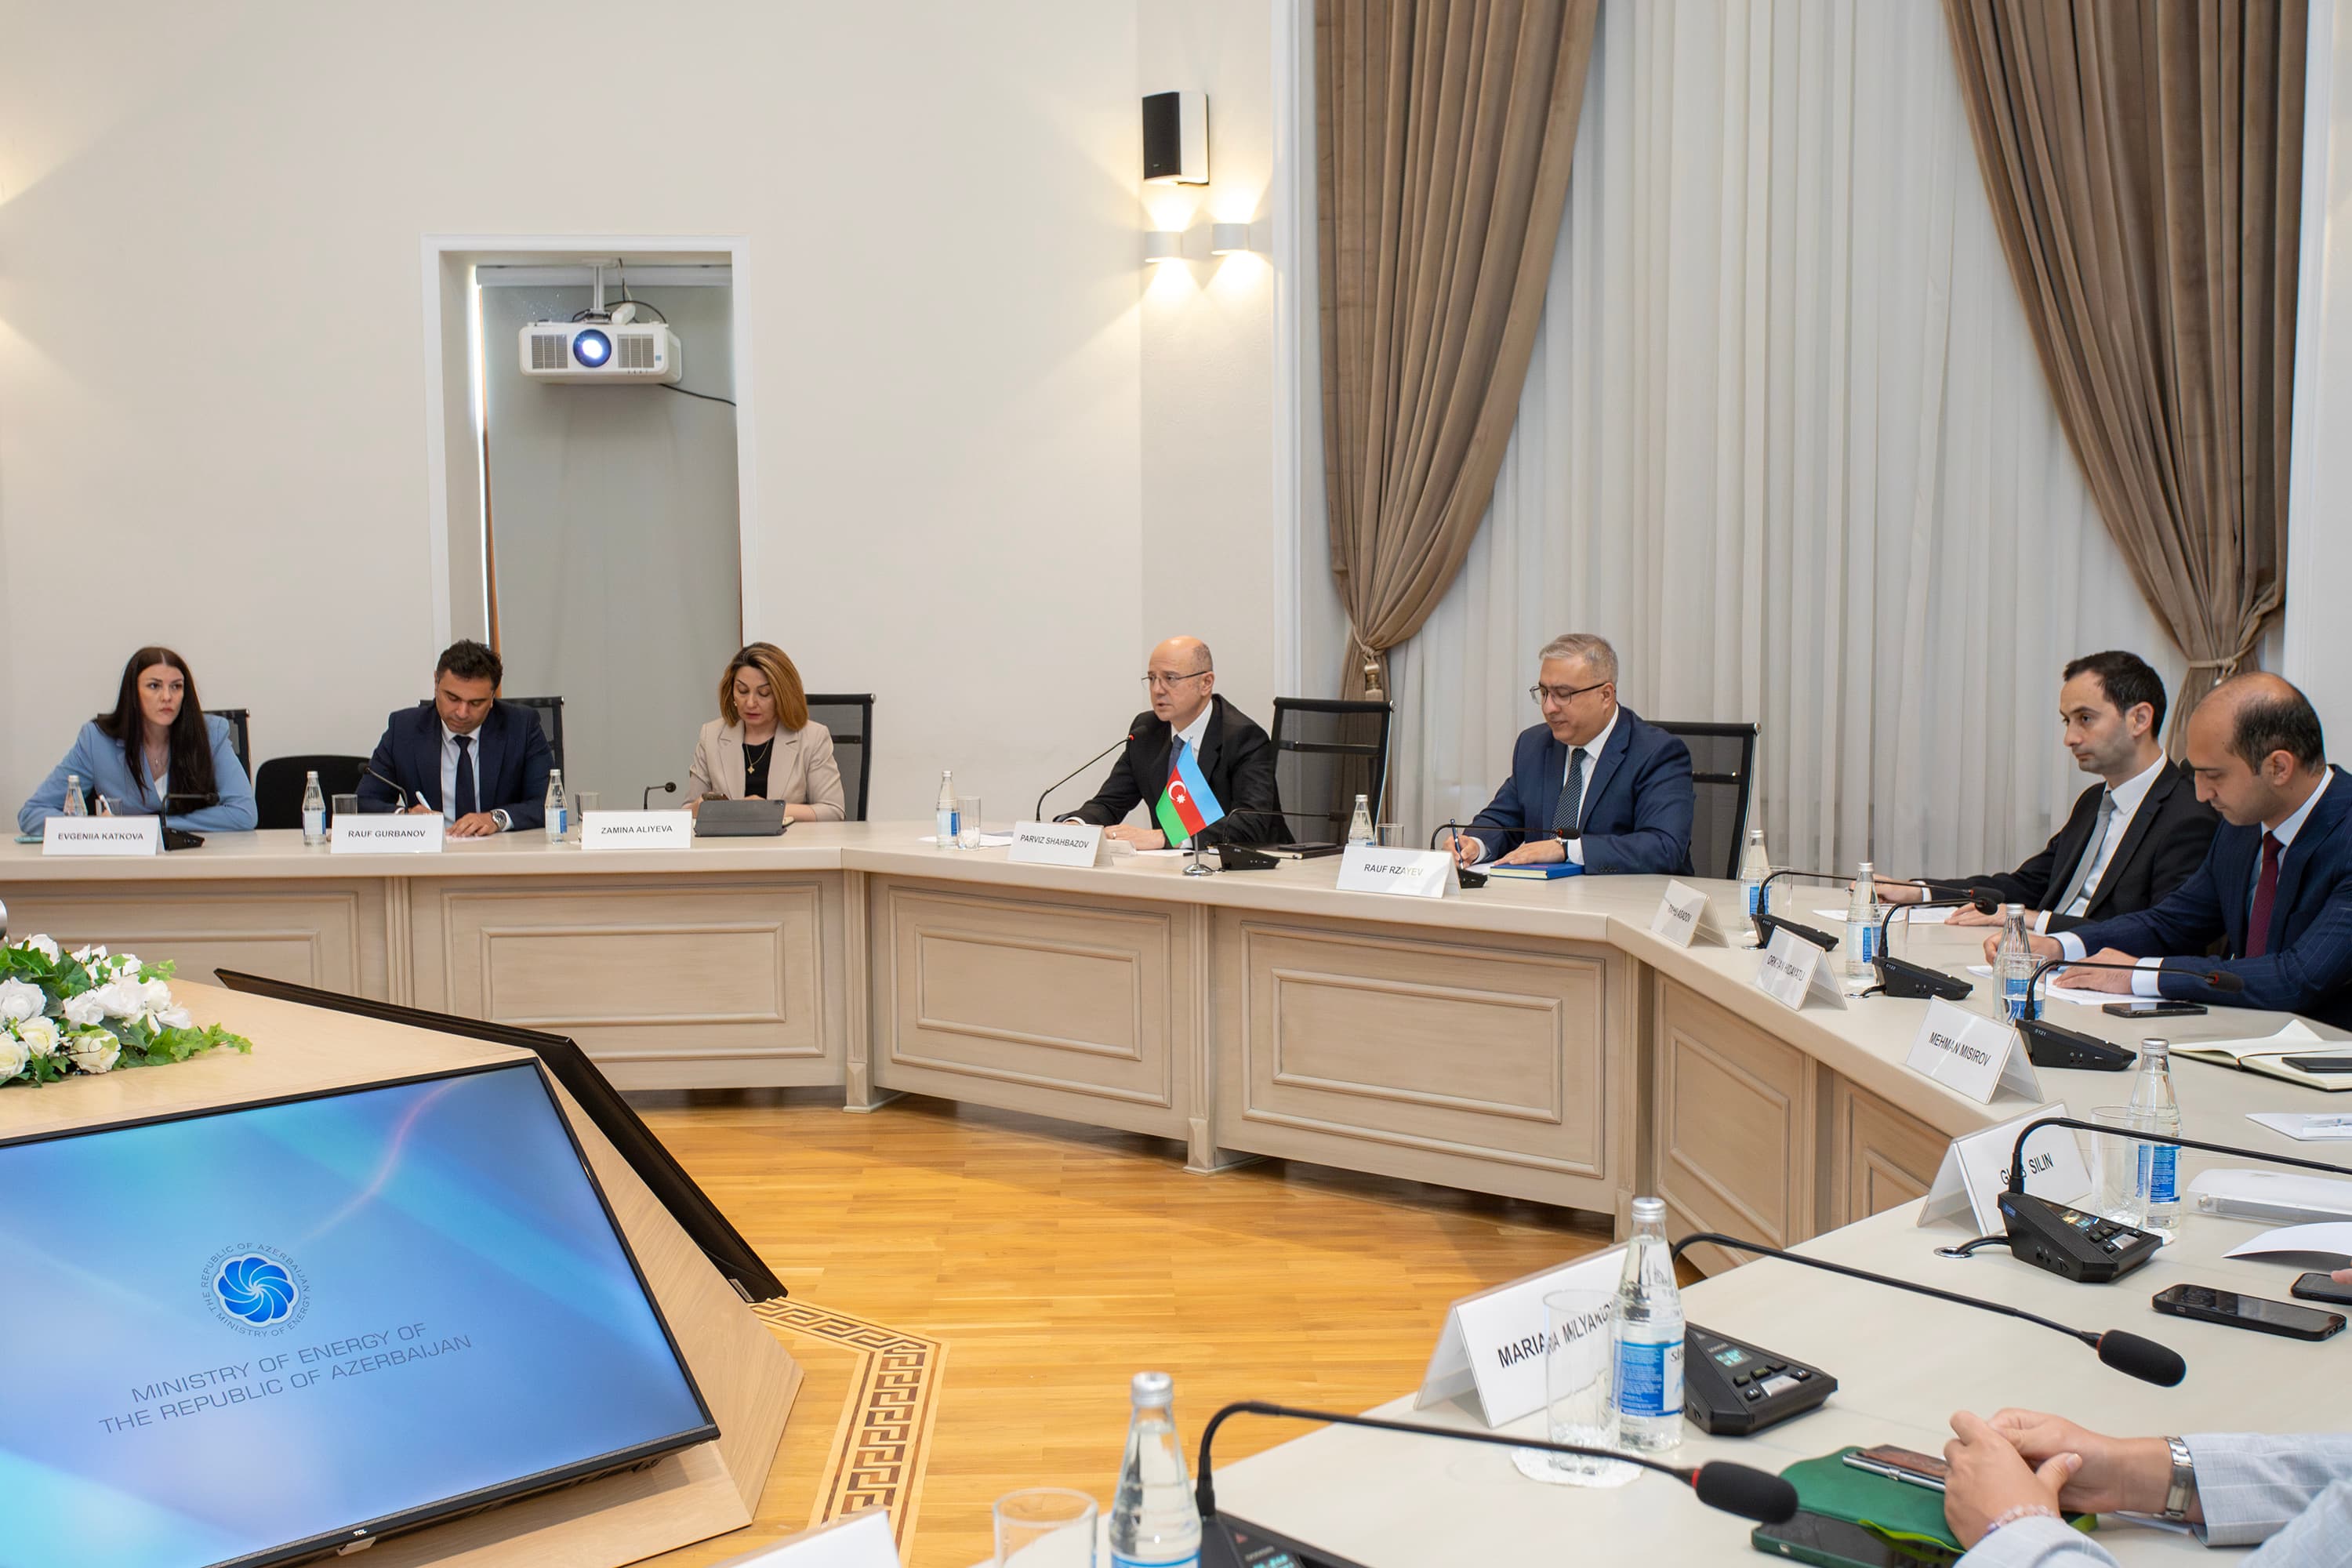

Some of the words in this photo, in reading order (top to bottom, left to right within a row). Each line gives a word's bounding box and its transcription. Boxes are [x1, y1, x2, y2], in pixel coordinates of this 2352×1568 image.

[636, 825, 673, 833] ALIYEVA
[1020, 834, 1045, 844] PARVIZ
[1045, 837, 1090, 848] SHAHBAZOV
[1364, 864, 1388, 873] RAUF
[1388, 866, 1423, 876] RZAYEV
[1929, 1032, 1962, 1054] MEHMAN
[1958, 1044, 1991, 1066] MISIROV
[2028, 1152, 2054, 1174] SILIN
[237, 1242, 252, 1250] OF
[201, 1245, 234, 1288] REPUBLIC
[257, 1243, 310, 1293] AZERBAIJAN
[201, 1291, 216, 1312] THE
[216, 1312, 268, 1338] MINISTRY
[270, 1326, 287, 1337] OF
[287, 1294, 310, 1330] ENERGY
[131, 1361, 249, 1403] MINISTRY
[258, 1353, 289, 1373] OF
[298, 1330, 389, 1364] ENERGY
[397, 1322, 426, 1341] OF
[99, 1409, 153, 1434] THE
[159, 1378, 283, 1421] REPUBLIC
[290, 1369, 321, 1388] OF
[331, 1334, 472, 1381] AZERBAIJAN
